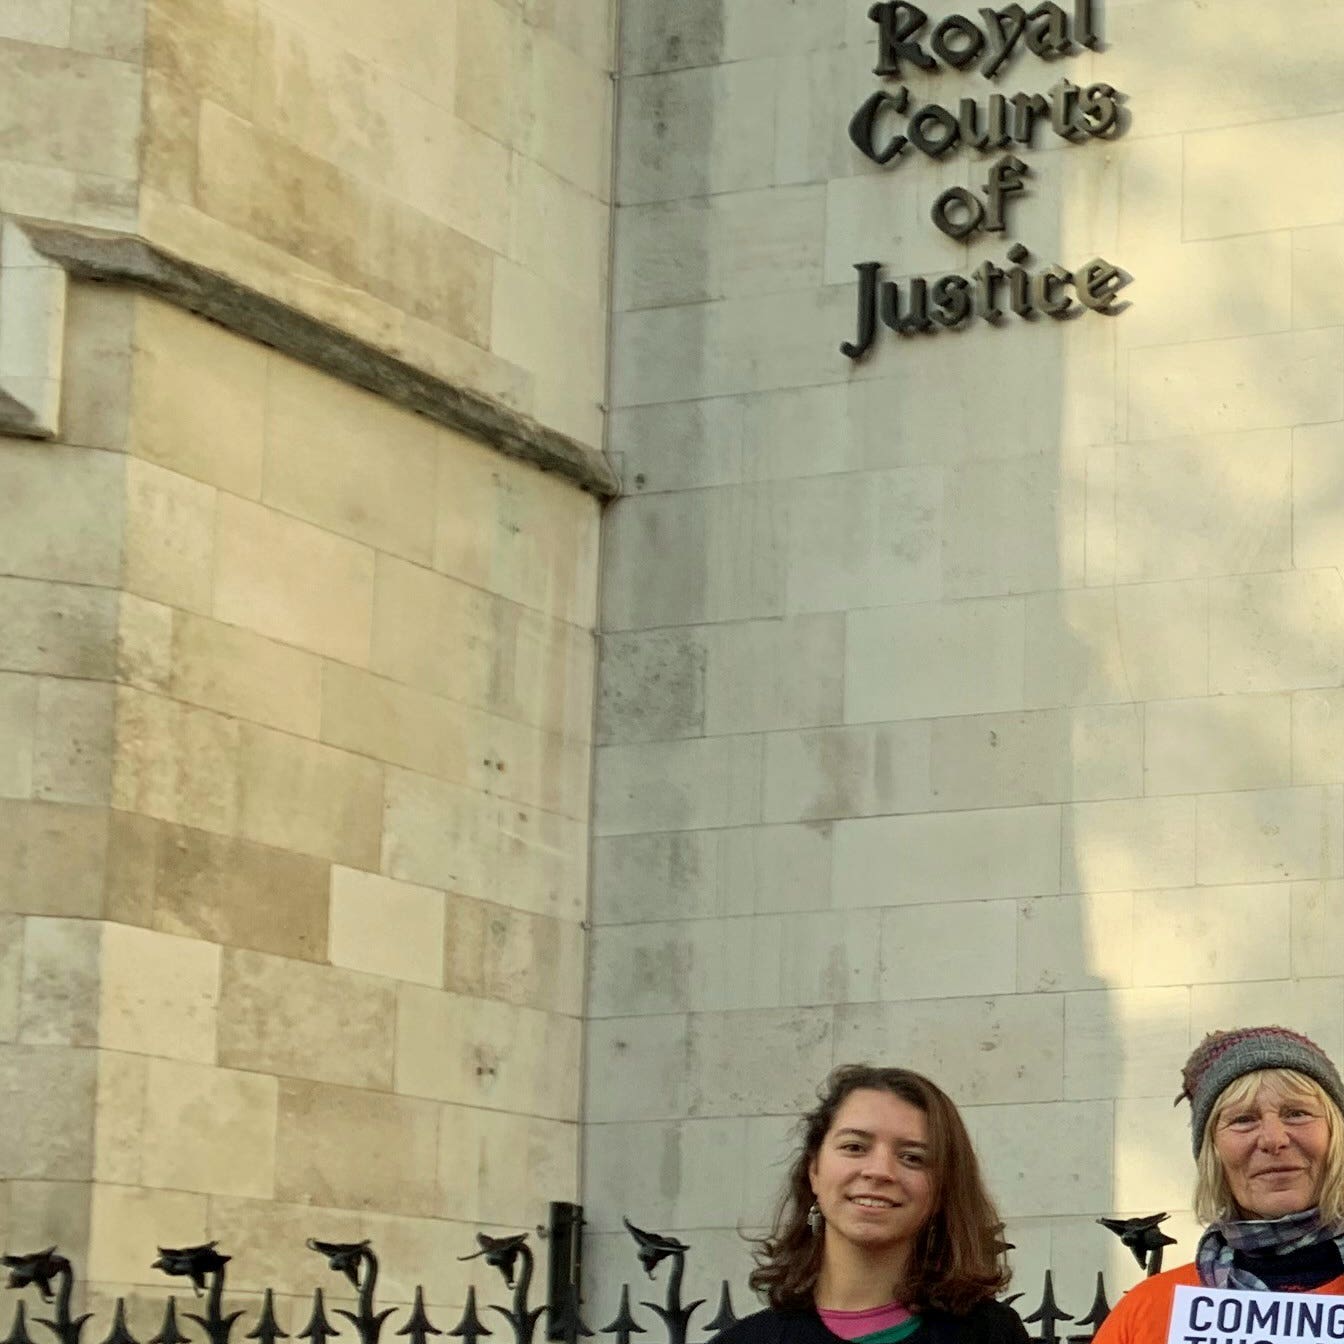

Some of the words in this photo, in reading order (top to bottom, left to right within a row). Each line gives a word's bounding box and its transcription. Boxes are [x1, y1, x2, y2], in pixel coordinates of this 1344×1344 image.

[868, 0, 1098, 78] Royal
[848, 78, 1124, 164] Courts
[931, 155, 1029, 240] of
[840, 243, 1134, 358] Justice
